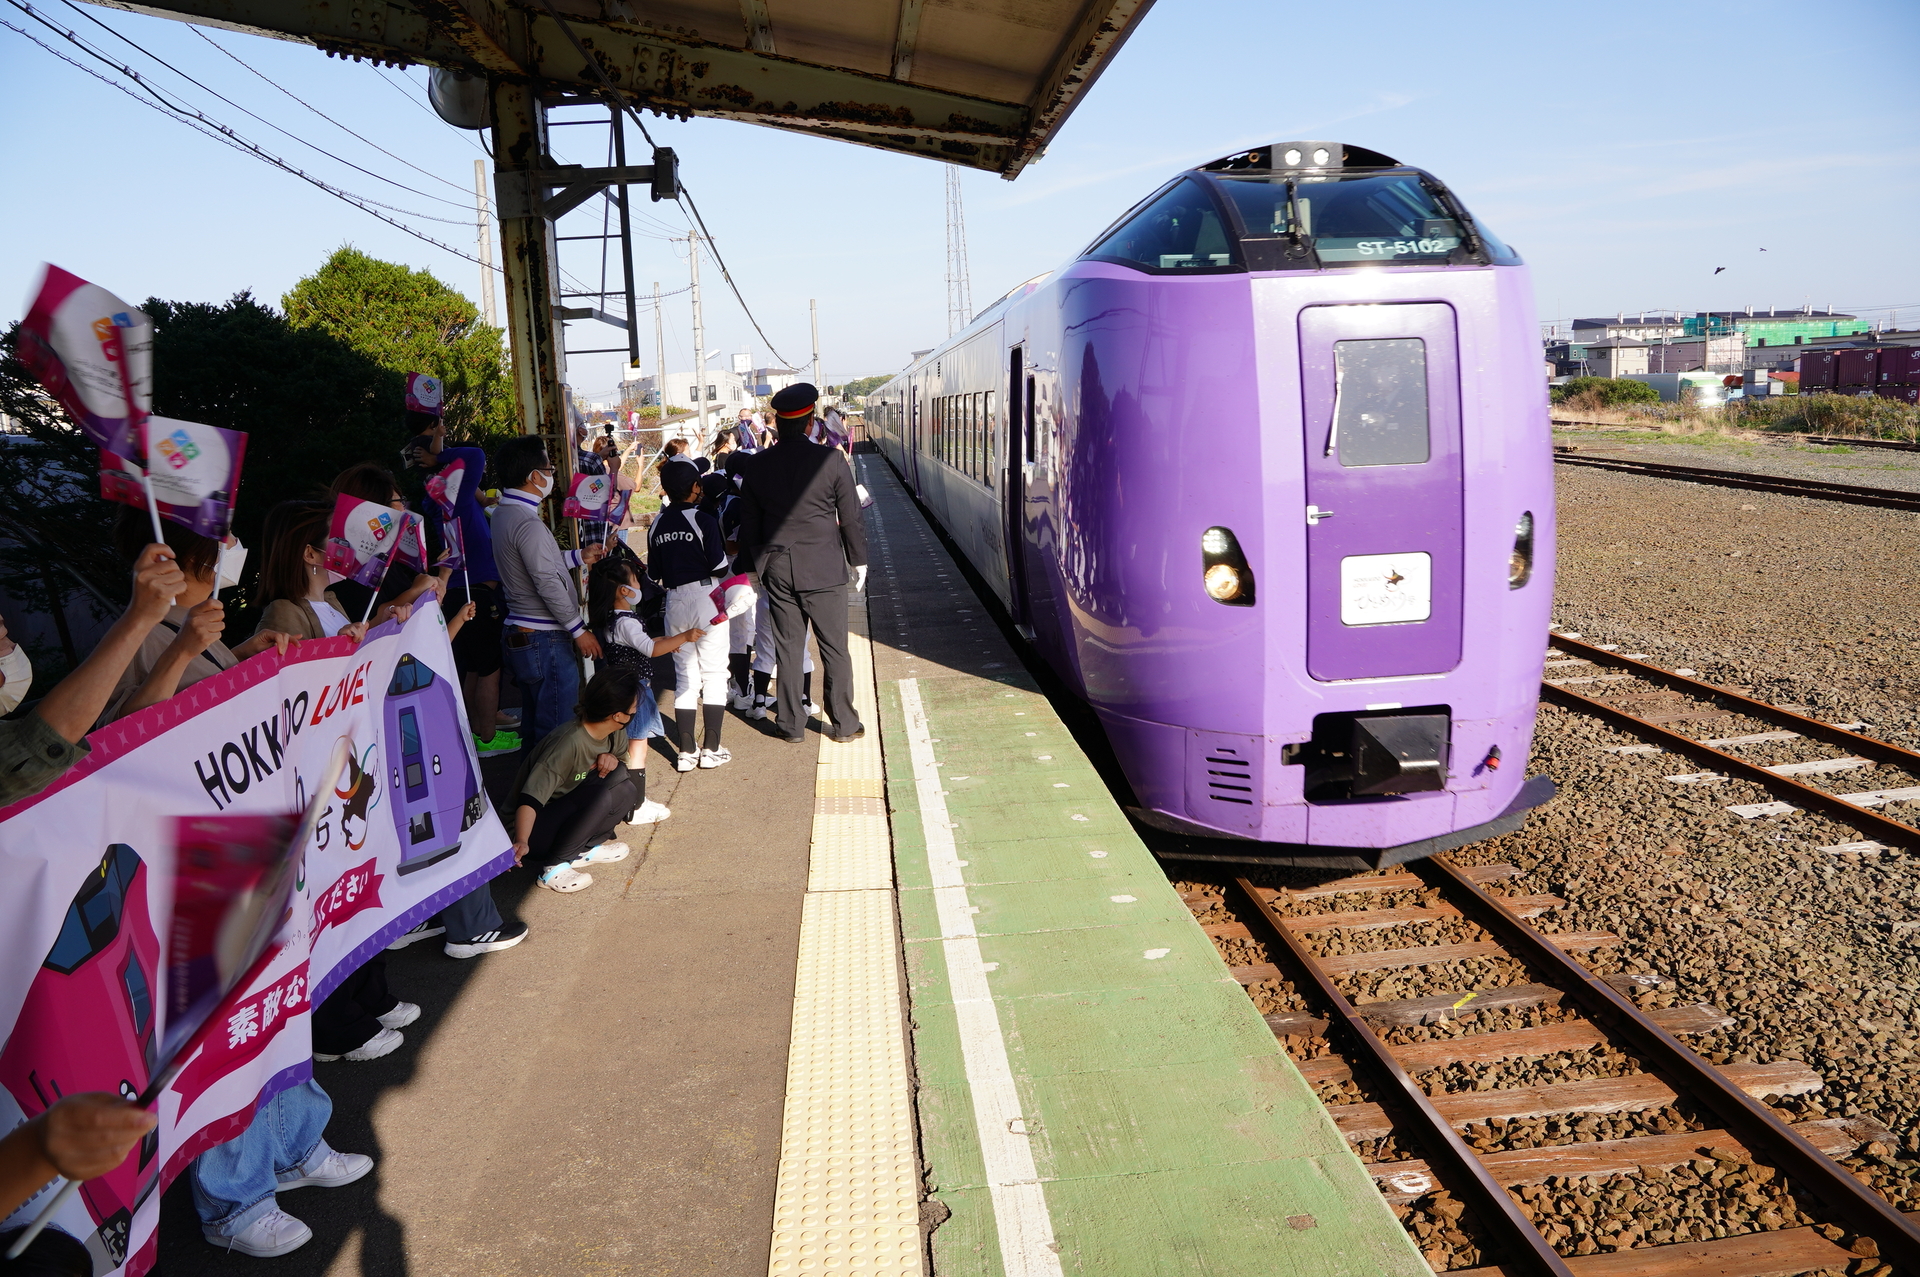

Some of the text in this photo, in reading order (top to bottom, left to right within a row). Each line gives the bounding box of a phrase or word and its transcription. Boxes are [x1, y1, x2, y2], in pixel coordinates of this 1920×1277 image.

[1357, 240, 1447, 255] ST-5102
[1865, 352, 1874, 360] JR
[1907, 389, 1917, 397] JR
[655, 532, 694, 546] HIROTO
[194, 691, 309, 811] HOKKDO
